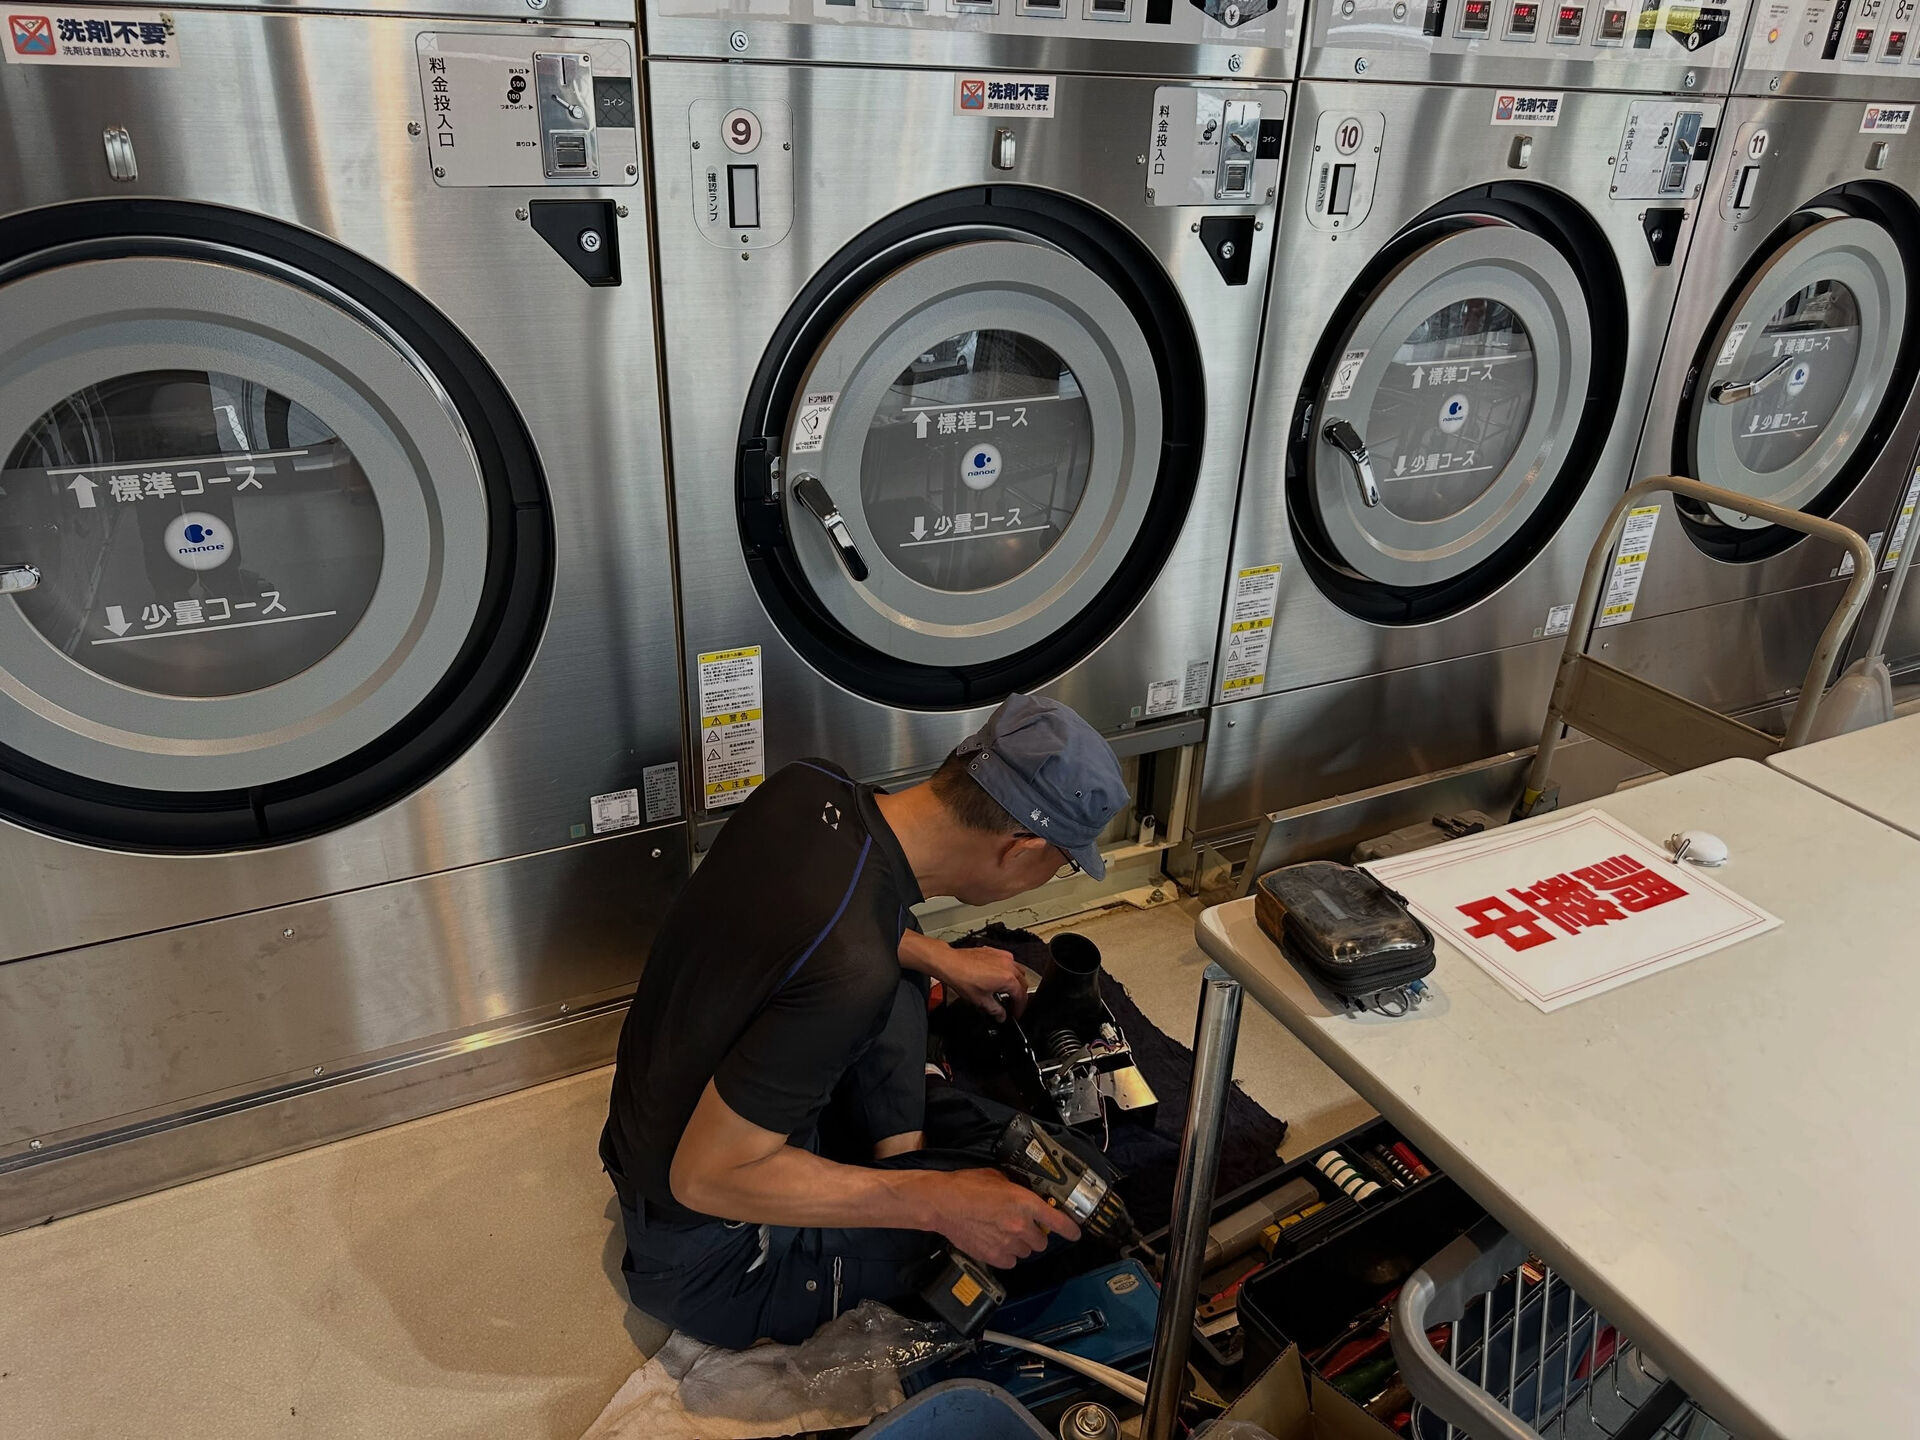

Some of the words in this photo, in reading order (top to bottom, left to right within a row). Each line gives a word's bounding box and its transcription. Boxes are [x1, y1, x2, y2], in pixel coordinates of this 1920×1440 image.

[57, 18, 166, 45] 洗剤不要
[62, 46, 170, 58] 洗剤は自動投入されます。
[512, 80, 525, 88] 500
[988, 82, 1050, 101] 洗剤不要
[429, 57, 455, 148] 料金投入口
[603, 98, 625, 106] コイン
[988, 102, 1049, 111] 洗剤は自動投入されます。
[1515, 97, 1558, 113] 洗剤不要
[731, 117, 752, 145] 9
[1154, 105, 1170, 175] 料金投入口
[1341, 125, 1358, 149] 10
[1751, 135, 1766, 154] 11
[707, 172, 718, 222] 確認ランプ
[1785, 336, 1831, 354] 標準コース
[1428, 364, 1493, 386] 標準コース
[808, 394, 834, 404] ドア操作
[937, 407, 1028, 435] 標準コース
[967, 468, 996, 477] nanoe
[1410, 450, 1475, 473] 少量コース
[108, 465, 263, 503] 標準コース
[934, 508, 1022, 536] 少量コース
[178, 542, 225, 555] nanoe
[141, 591, 287, 630] 少量コース
[1455, 854, 1690, 953] 調整中
